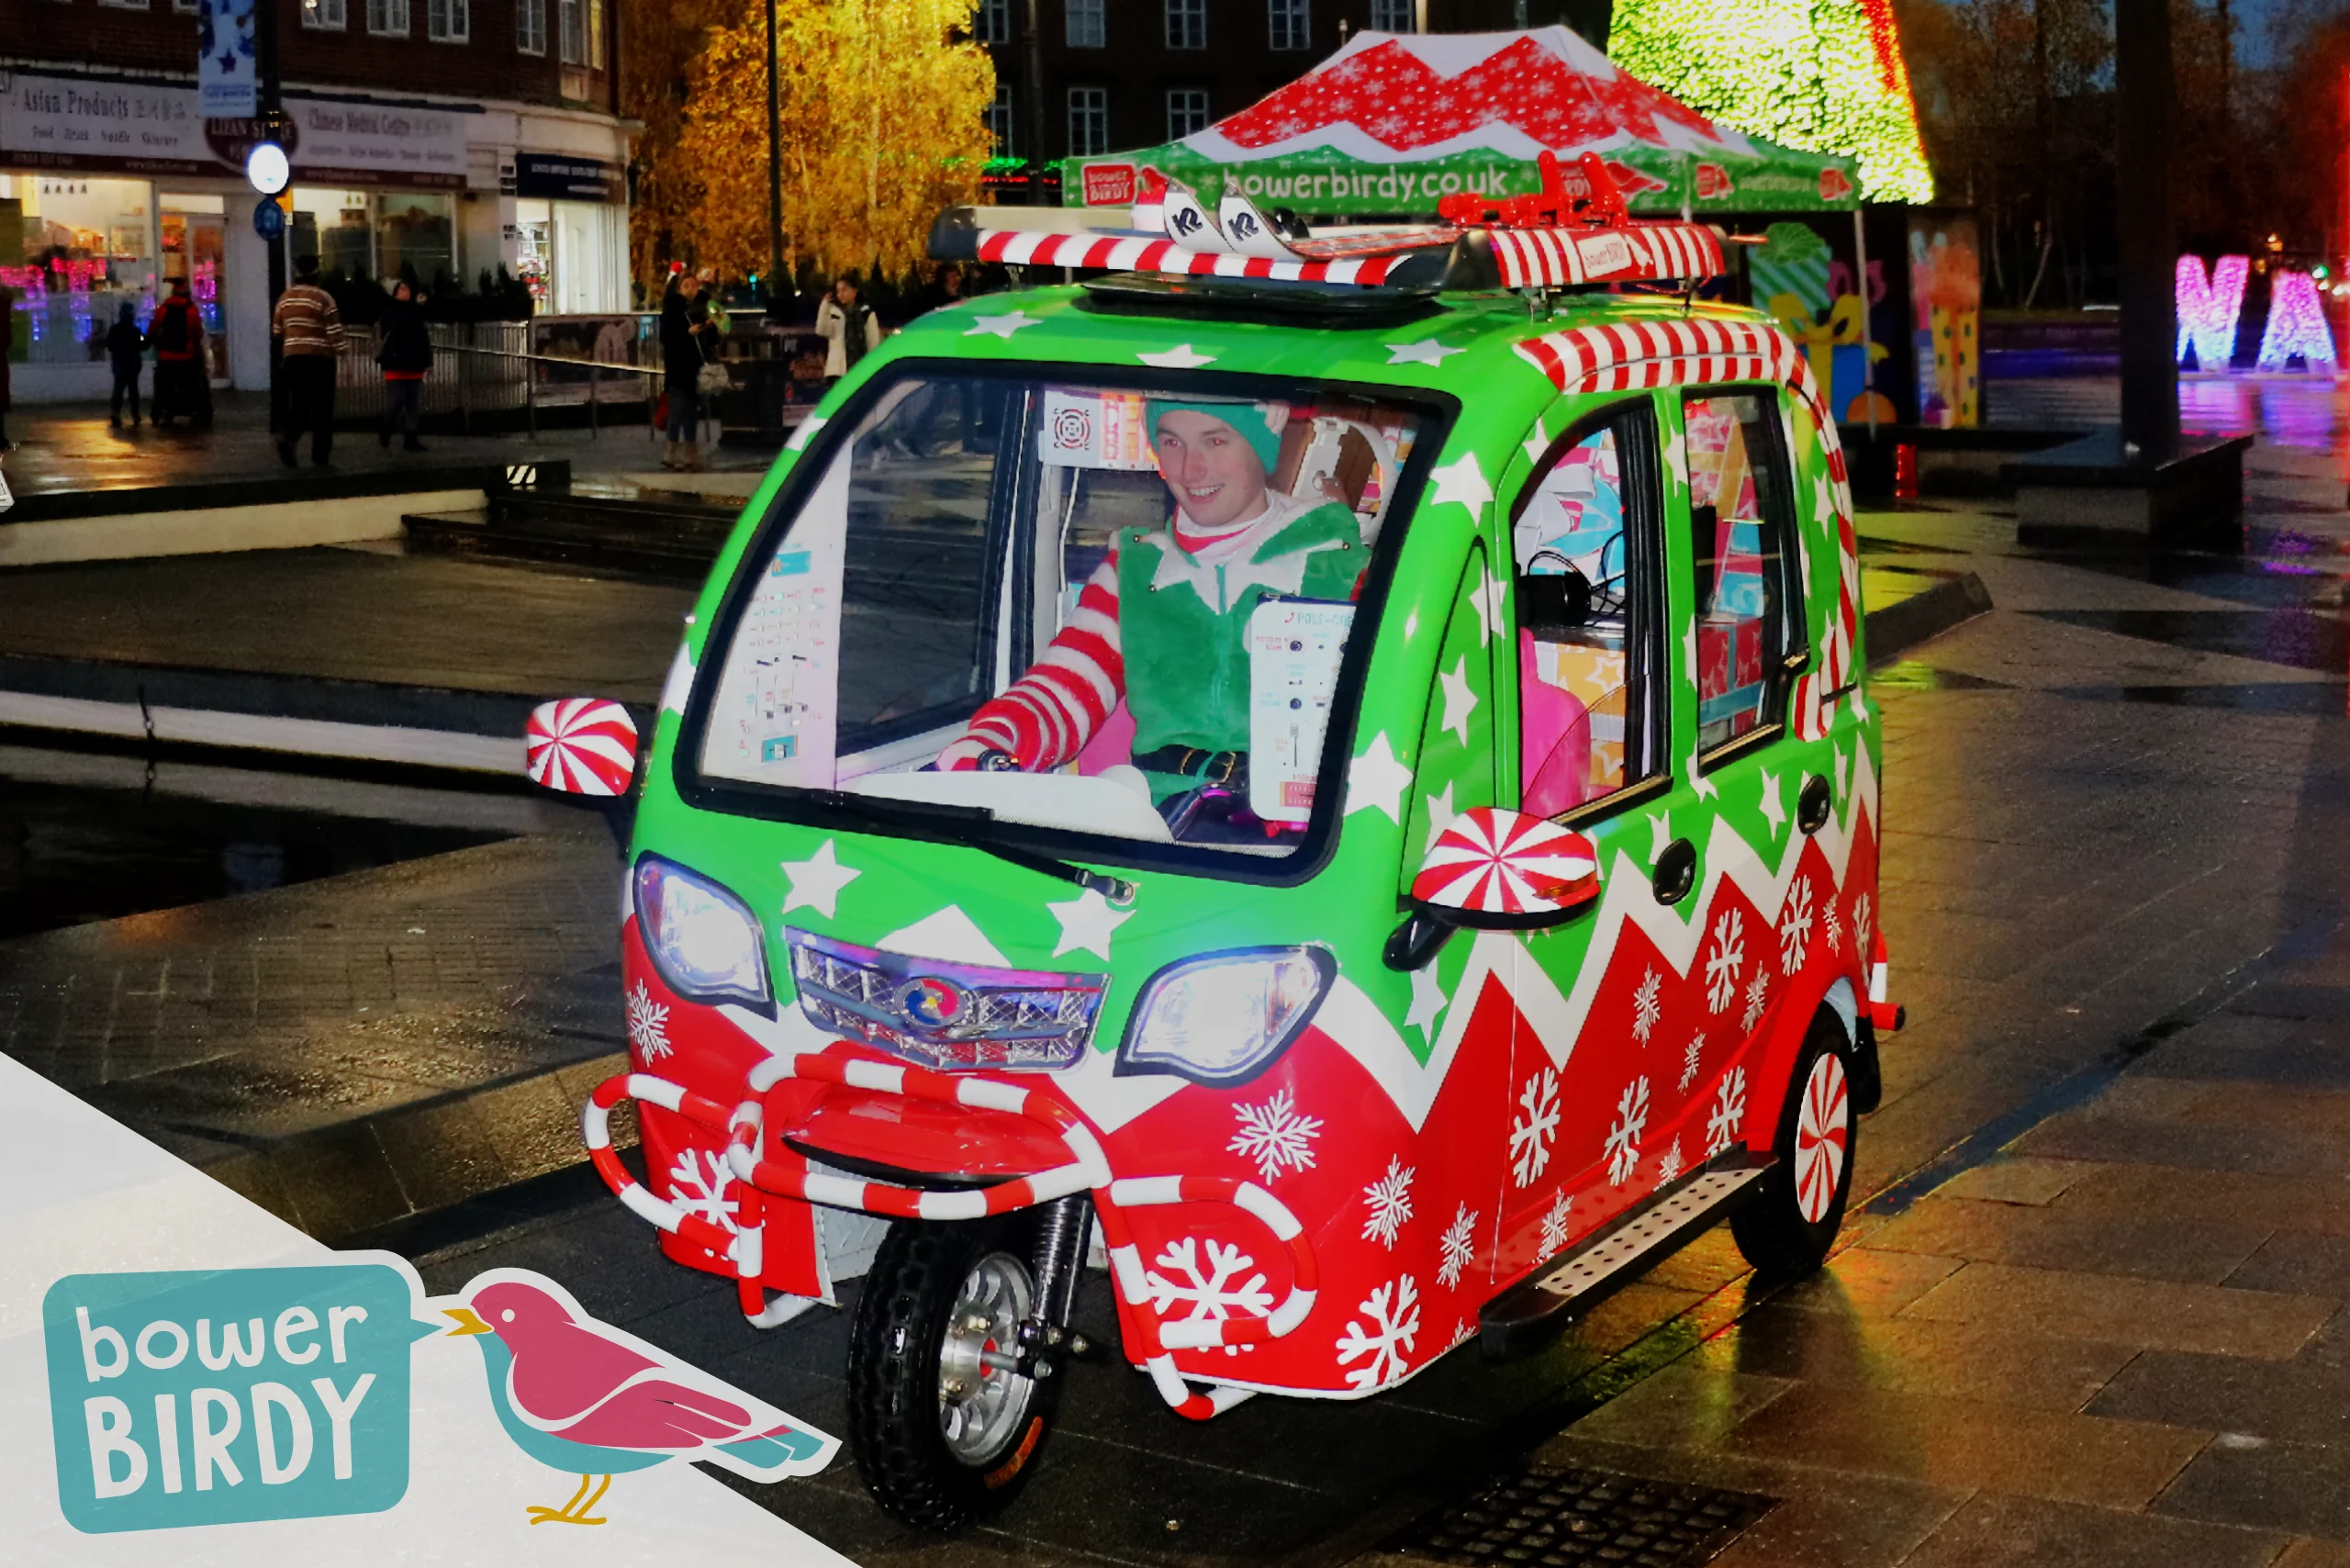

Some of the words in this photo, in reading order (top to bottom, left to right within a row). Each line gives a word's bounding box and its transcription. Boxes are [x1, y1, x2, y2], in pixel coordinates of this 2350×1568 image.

[66, 90, 129, 120] Products
[1089, 171, 1129, 184] bower
[1224, 163, 1509, 203] bowerbirdy.couk
[1090, 182, 1131, 201] BIRDY
